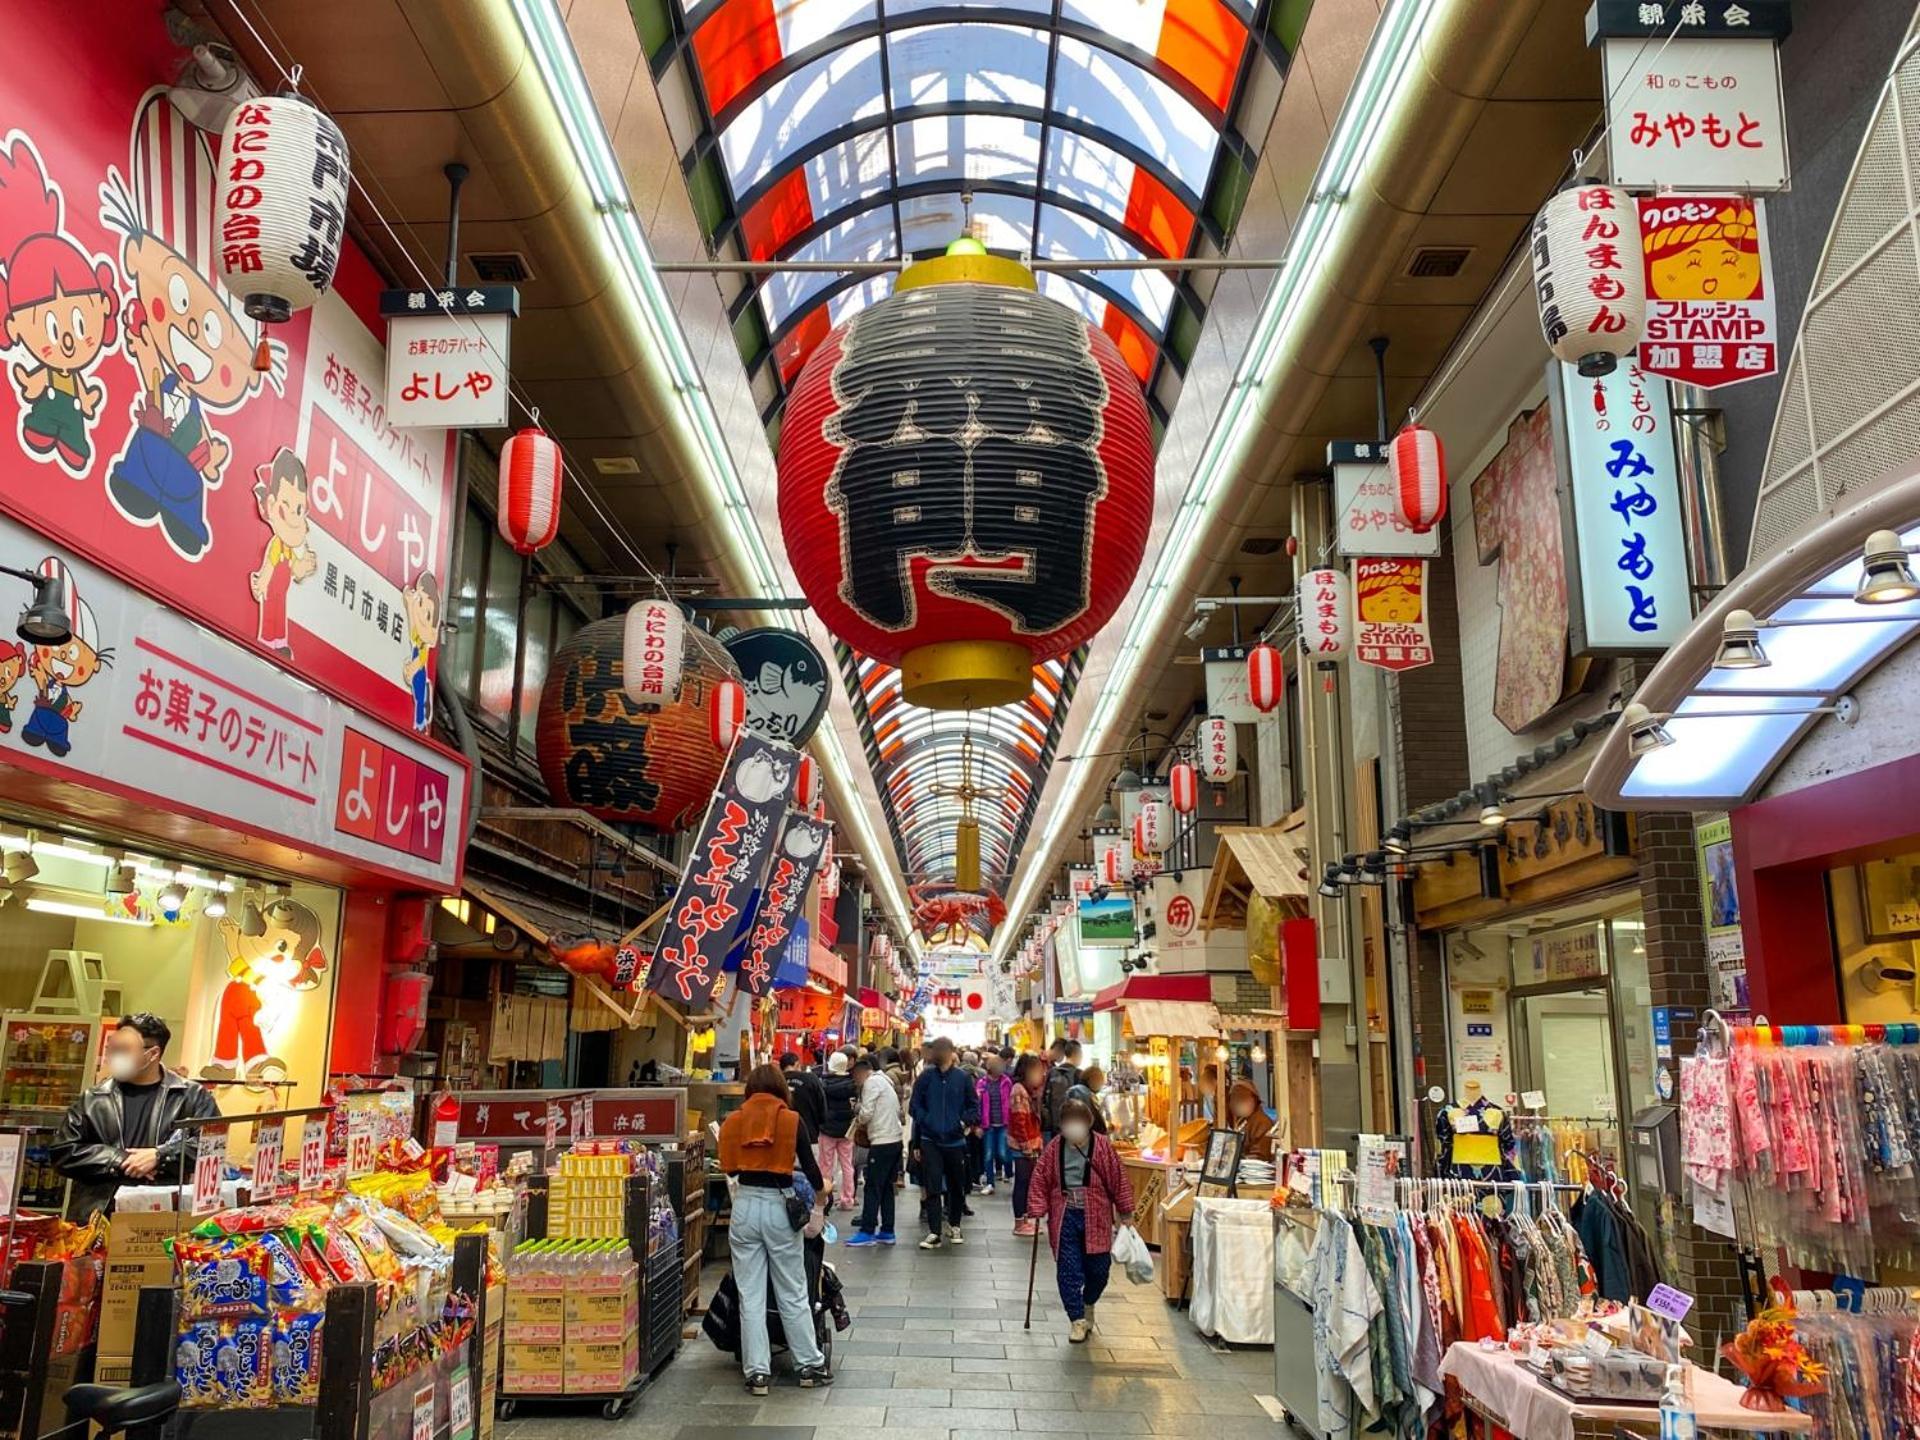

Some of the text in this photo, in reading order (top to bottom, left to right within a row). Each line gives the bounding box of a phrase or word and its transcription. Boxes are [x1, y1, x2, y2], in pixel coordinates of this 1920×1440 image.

[1646, 73, 1738, 90] 和のこもの
[1630, 112, 1763, 149] みやもと
[222, 104, 272, 274] なにわの台所
[1643, 202, 1717, 228] クロモン
[1577, 184, 1627, 335] ほんまもん
[1656, 301, 1752, 319] フレッシュ
[408, 336, 488, 356] お菓子のデパート
[1647, 319, 1766, 341] STAMP
[1648, 344, 1767, 370] 加盟店
[400, 371, 493, 401] よしや
[311, 437, 426, 583] よしや
[1604, 439, 1659, 633] みやもと
[1359, 562, 1400, 578] クロモン
[323, 562, 404, 644] 黒門市場店
[1315, 571, 1340, 653] ほんまもん
[1360, 633, 1425, 646] STAMP
[1364, 622, 1416, 634] フレッシュ
[640, 605, 667, 695] なにわの台所
[133, 667, 318, 784] お菓子のデパート
[746, 711, 799, 737] っちり
[1211, 720, 1228, 777] ほんまもん
[343, 748, 444, 848] よしや
[615, 948, 637, 983] 浜藤
